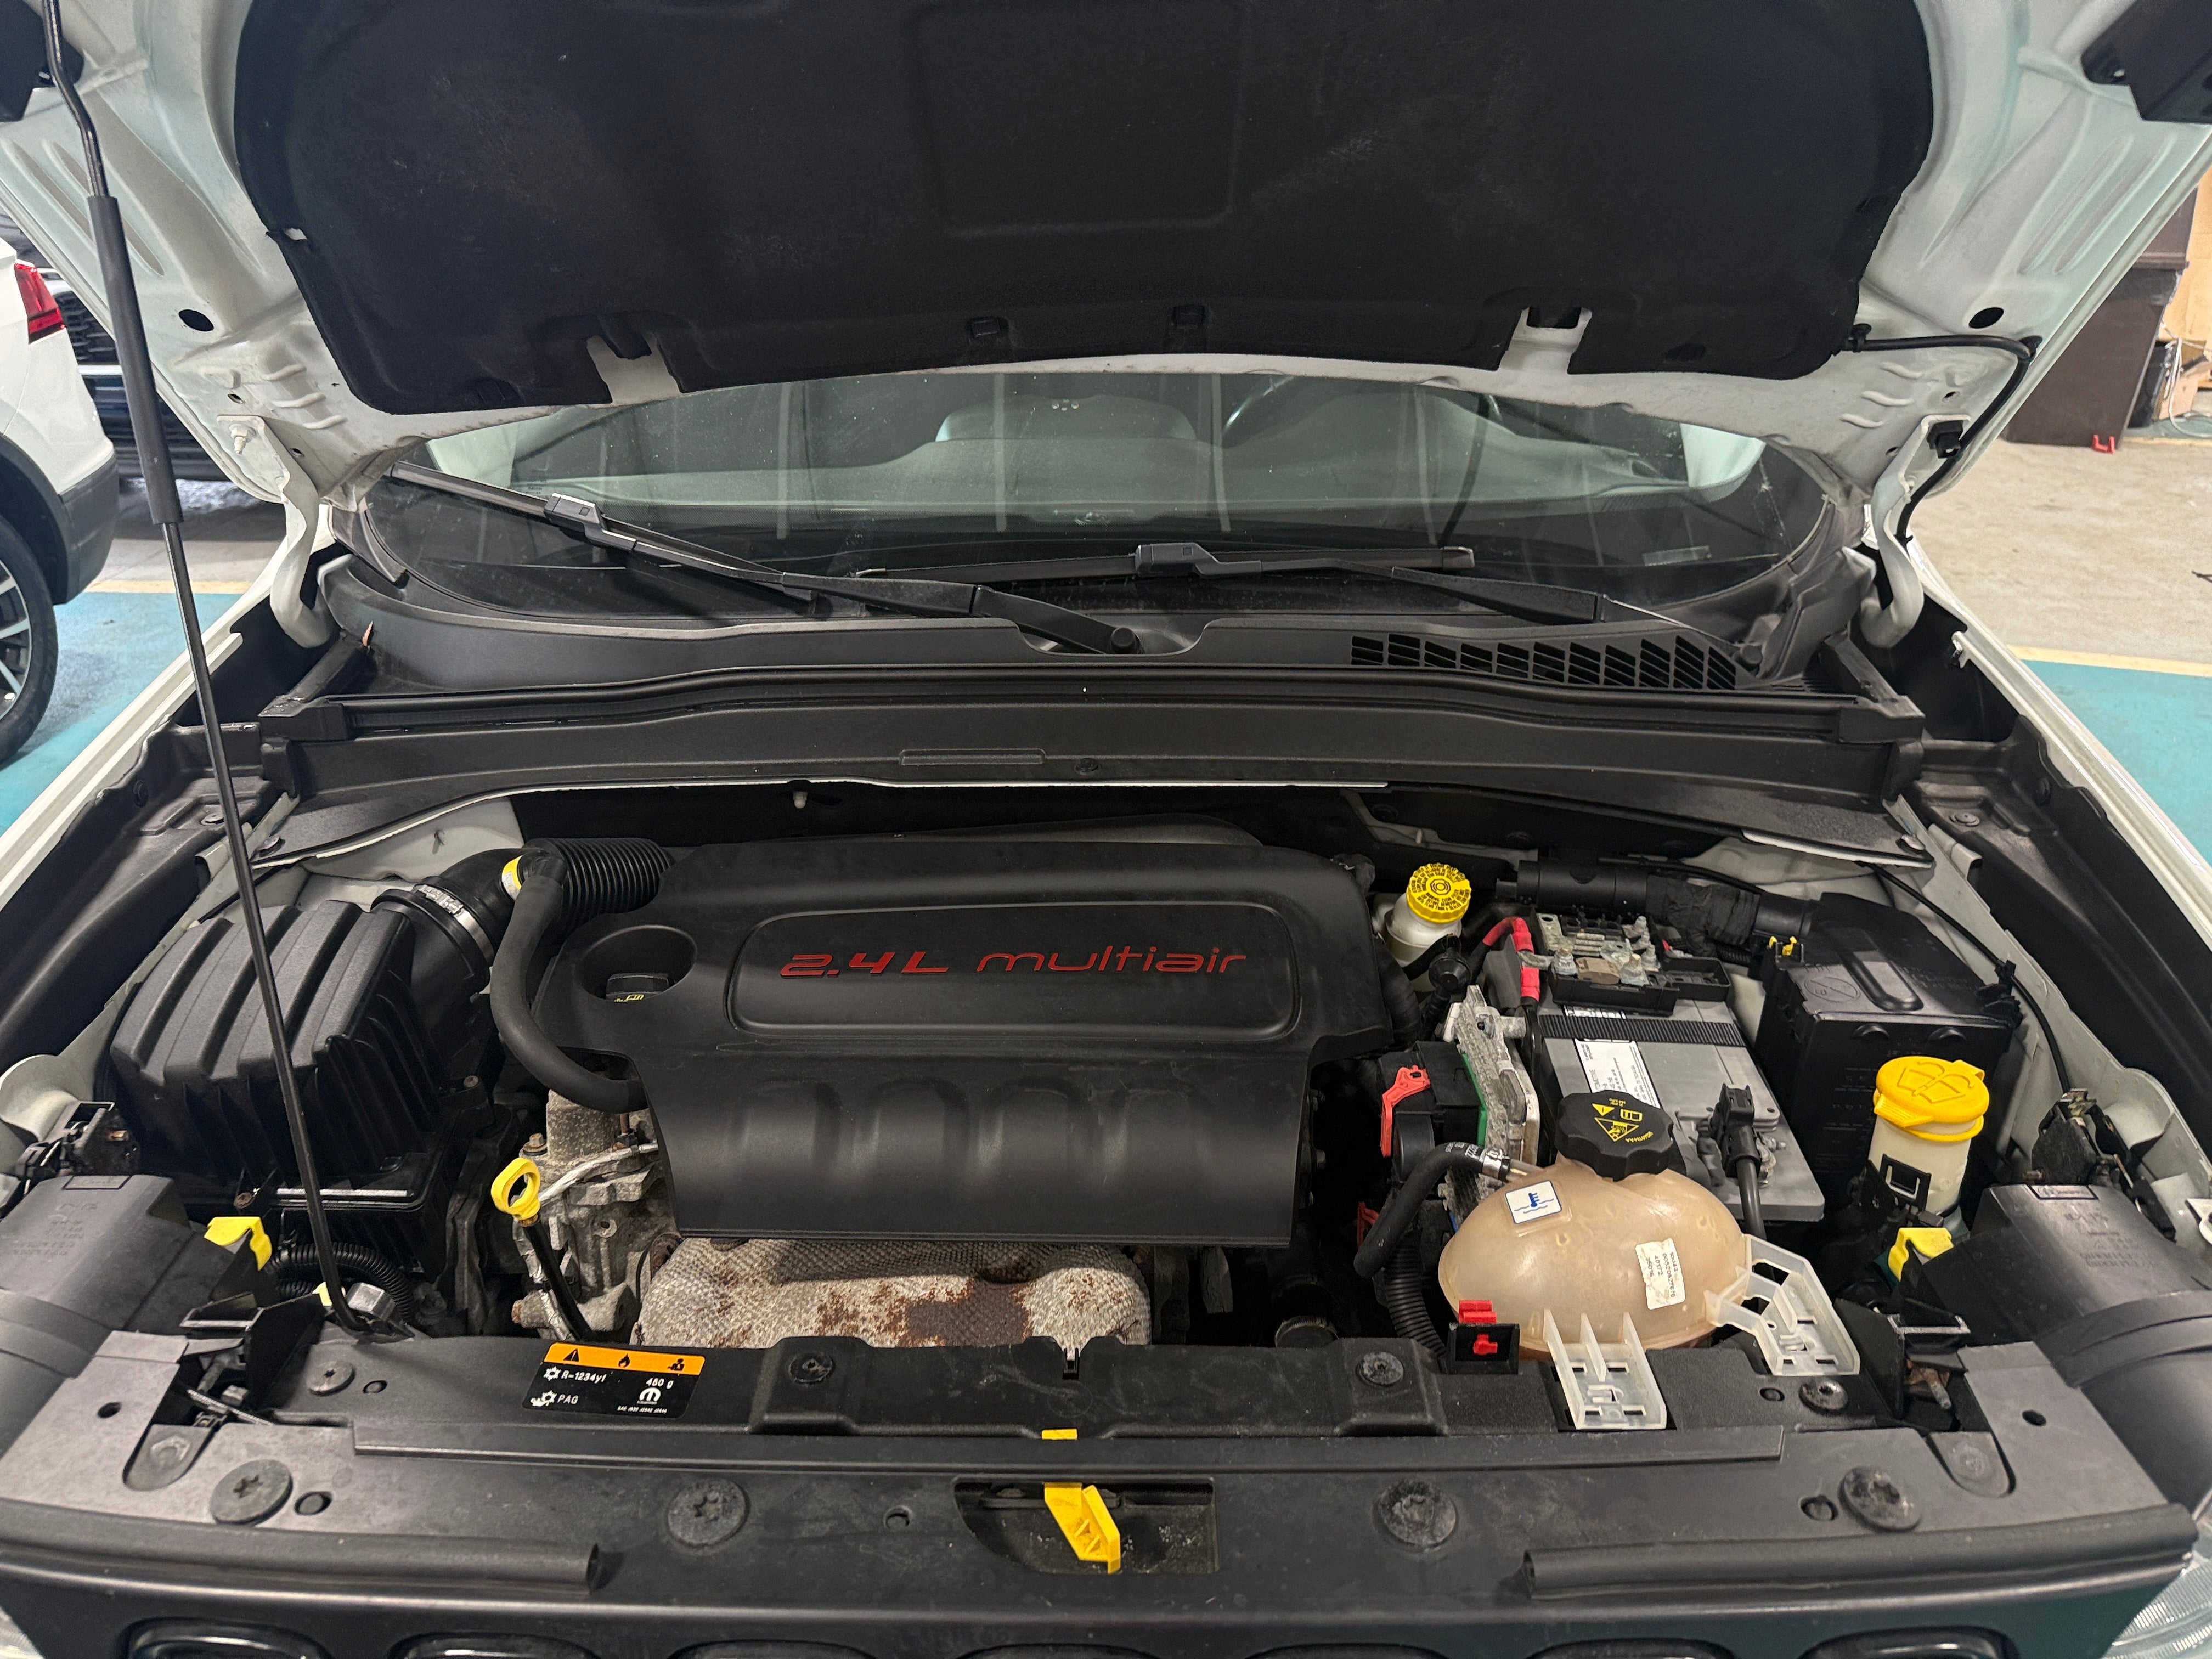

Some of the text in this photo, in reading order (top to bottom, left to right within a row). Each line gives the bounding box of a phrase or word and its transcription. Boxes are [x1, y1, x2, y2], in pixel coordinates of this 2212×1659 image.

[780, 946, 1247, 976] 2.4L multiair
[561, 1370, 607, 1384] R-1234yf
[557, 1393, 579, 1404] PAG
